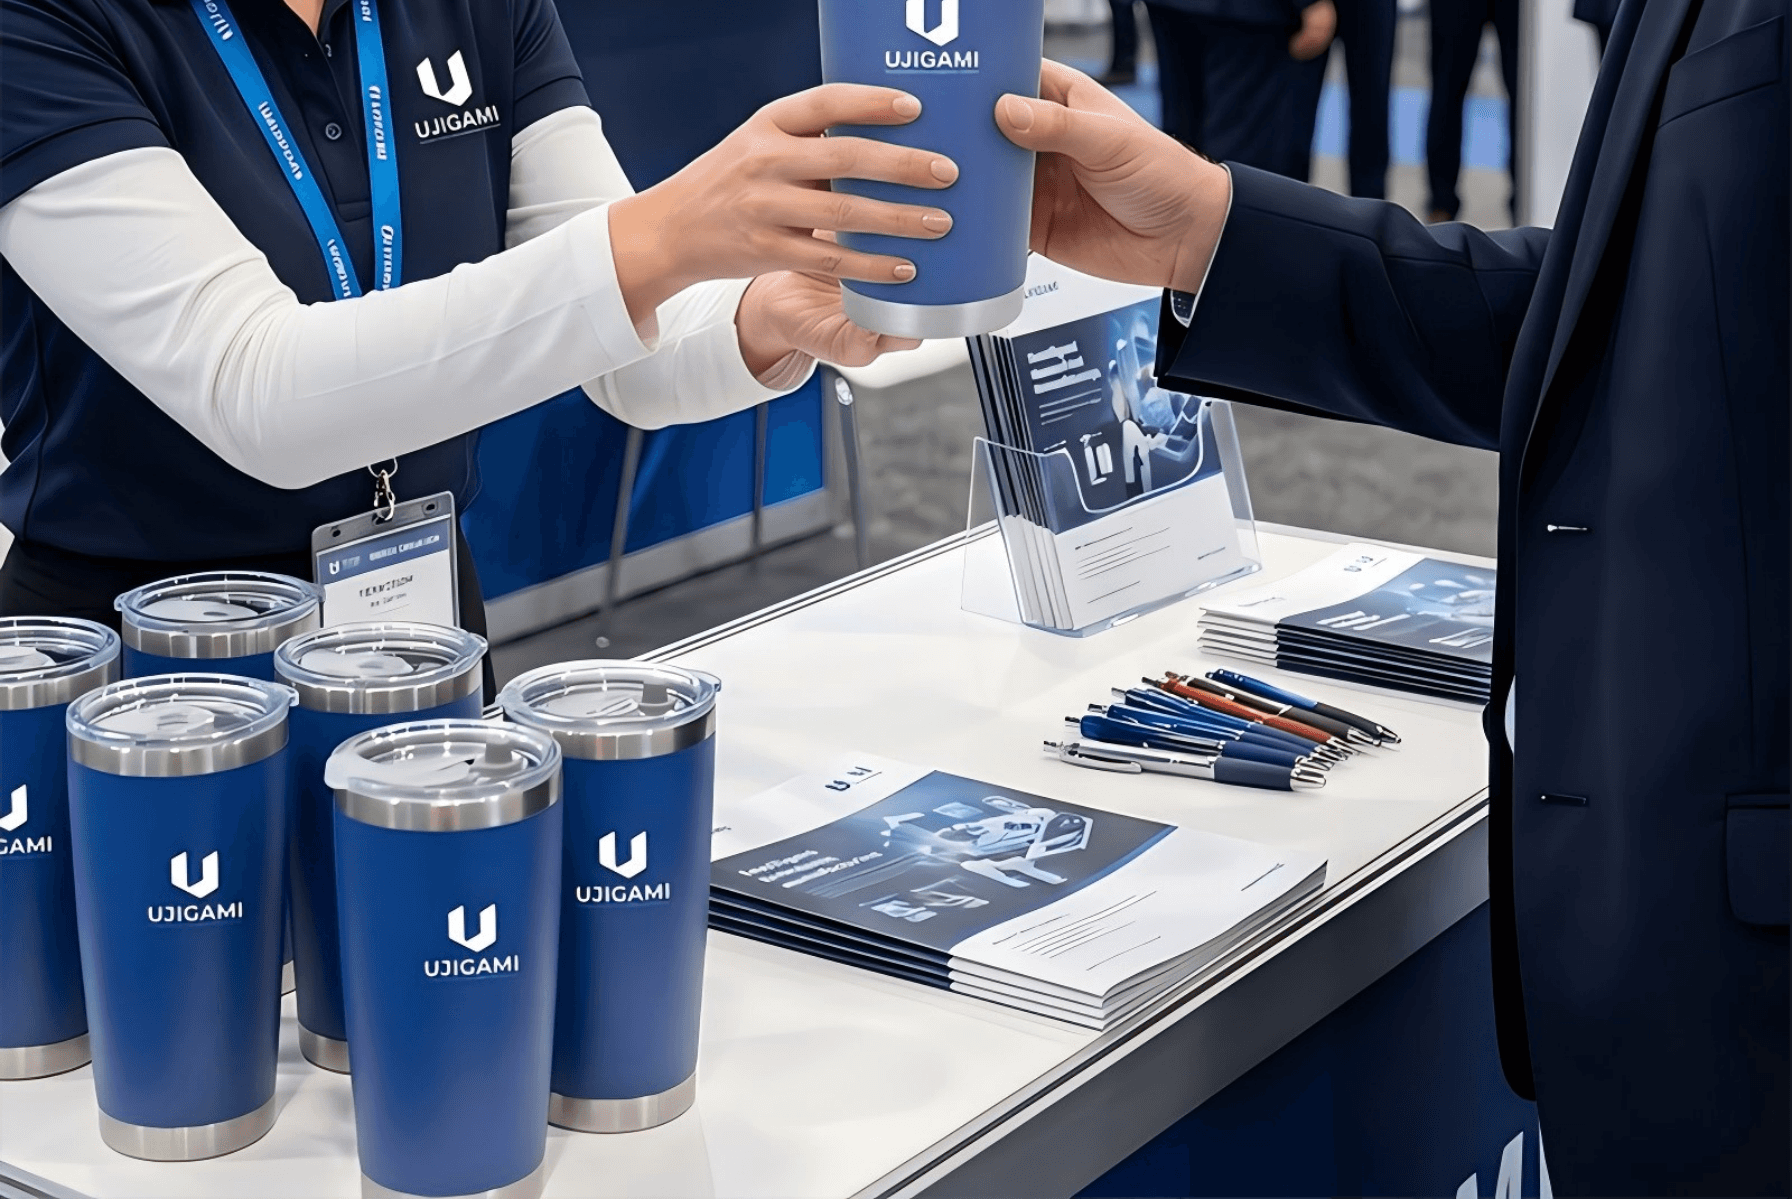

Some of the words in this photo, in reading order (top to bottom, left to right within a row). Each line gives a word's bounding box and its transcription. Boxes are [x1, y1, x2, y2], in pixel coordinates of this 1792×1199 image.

[886, 51, 978, 67] UJIGAMI
[415, 105, 498, 137] UJIGAMI
[577, 883, 669, 902] UJIGAMI
[149, 902, 242, 922] UJIGAMI
[425, 955, 518, 976] UJIGAMI
